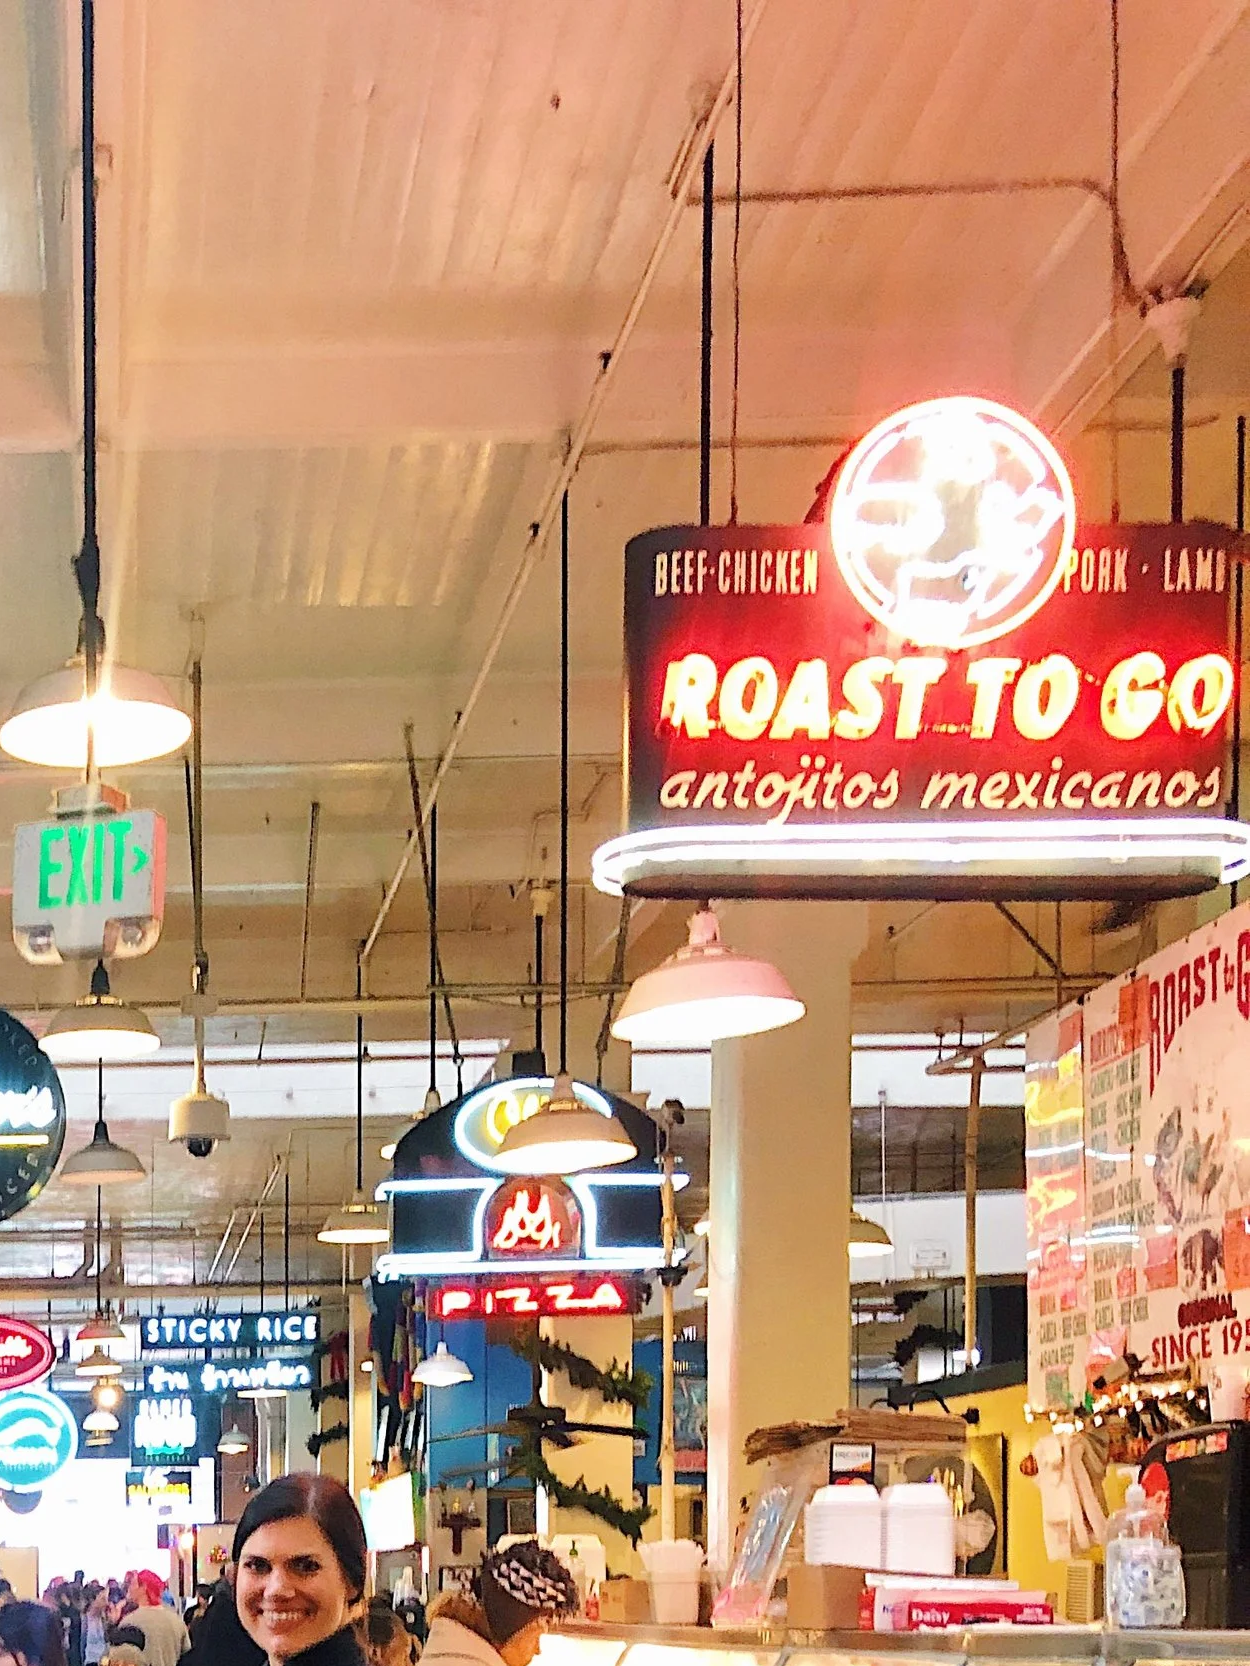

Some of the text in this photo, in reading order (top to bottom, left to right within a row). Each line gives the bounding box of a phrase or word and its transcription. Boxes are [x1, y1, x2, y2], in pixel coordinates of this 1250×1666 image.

[1062, 546, 1129, 594] PORK
[659, 650, 1235, 741] ROAST TO GO
[659, 754, 1222, 826] antojitos mexicanos
[38, 820, 133, 910] EXIT
[1150, 946, 1221, 1098] ROAST
[147, 1315, 318, 1344] STICKY RICE
[441, 1283, 623, 1317] PIZZA
[1152, 1325, 1212, 1369] SINCE
